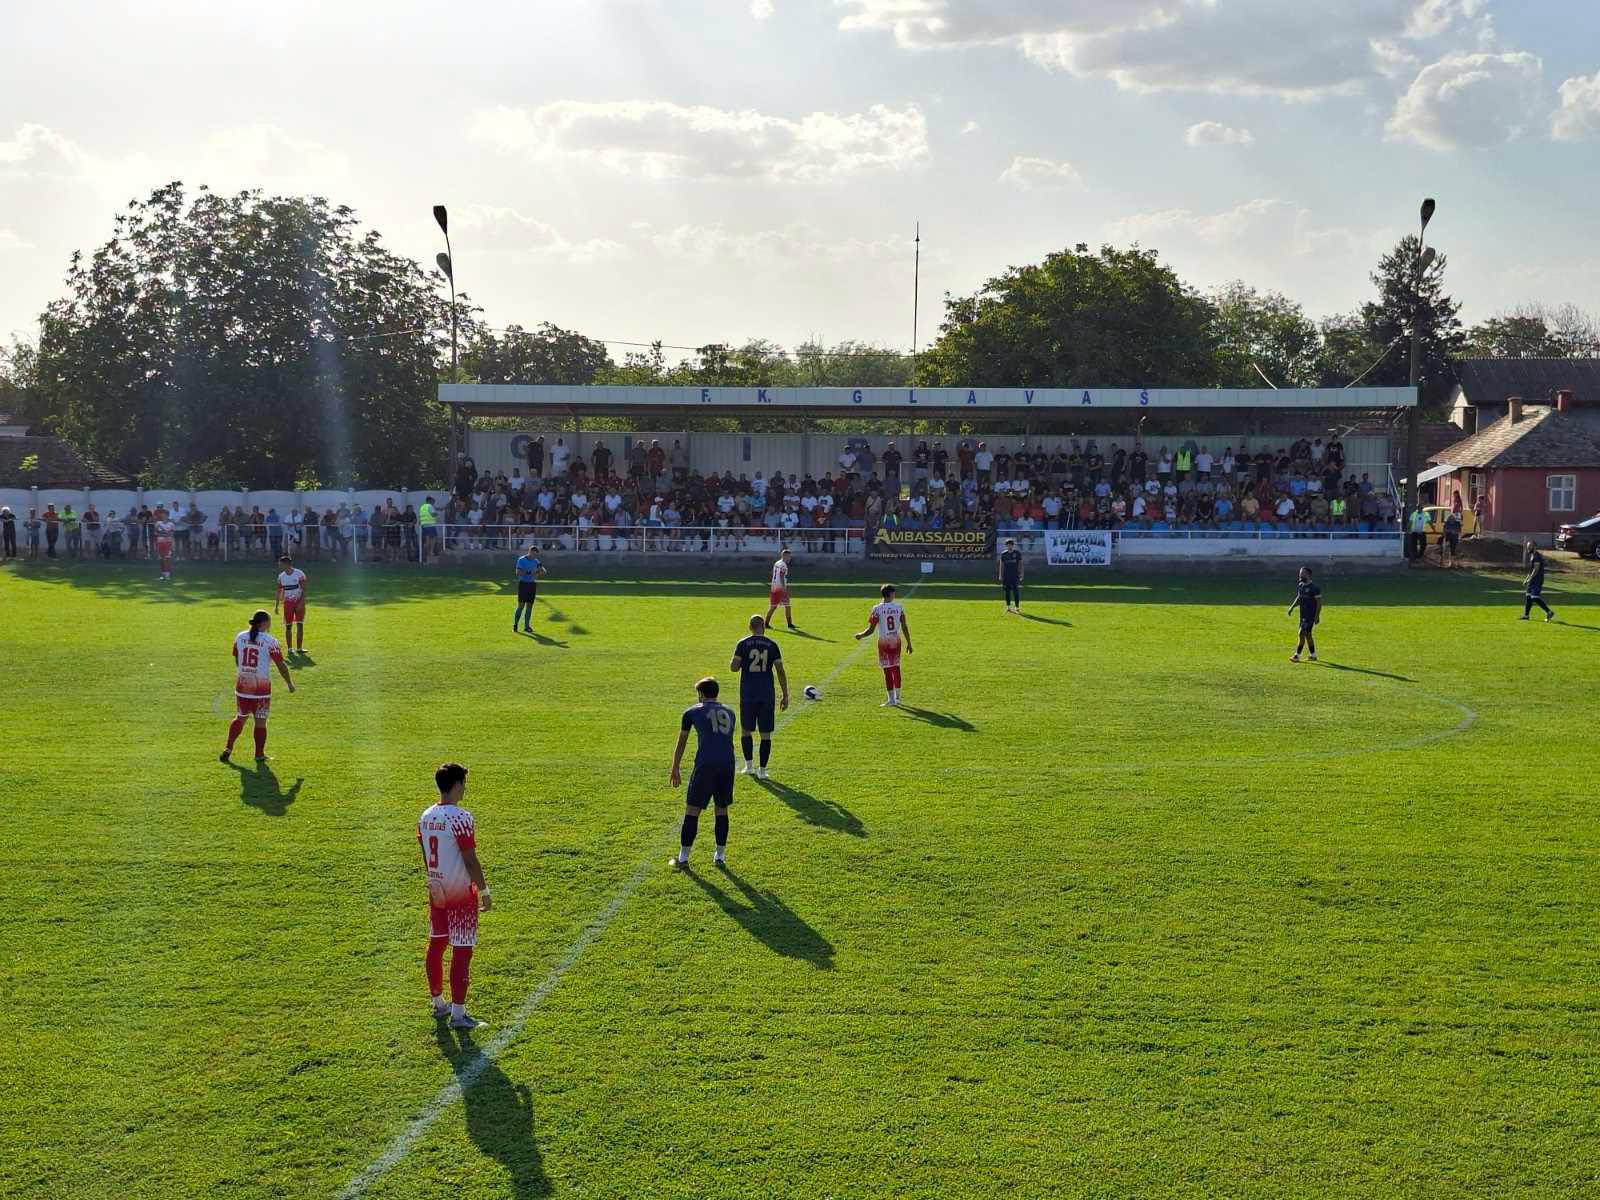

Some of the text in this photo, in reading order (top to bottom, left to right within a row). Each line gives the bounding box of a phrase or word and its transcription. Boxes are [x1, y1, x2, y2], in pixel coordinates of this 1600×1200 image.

[886, 615, 896, 631] 8
[241, 647, 259, 668] 16
[749, 648, 769, 673] 21
[706, 708, 732, 735] 19
[429, 836, 439, 869] 9
